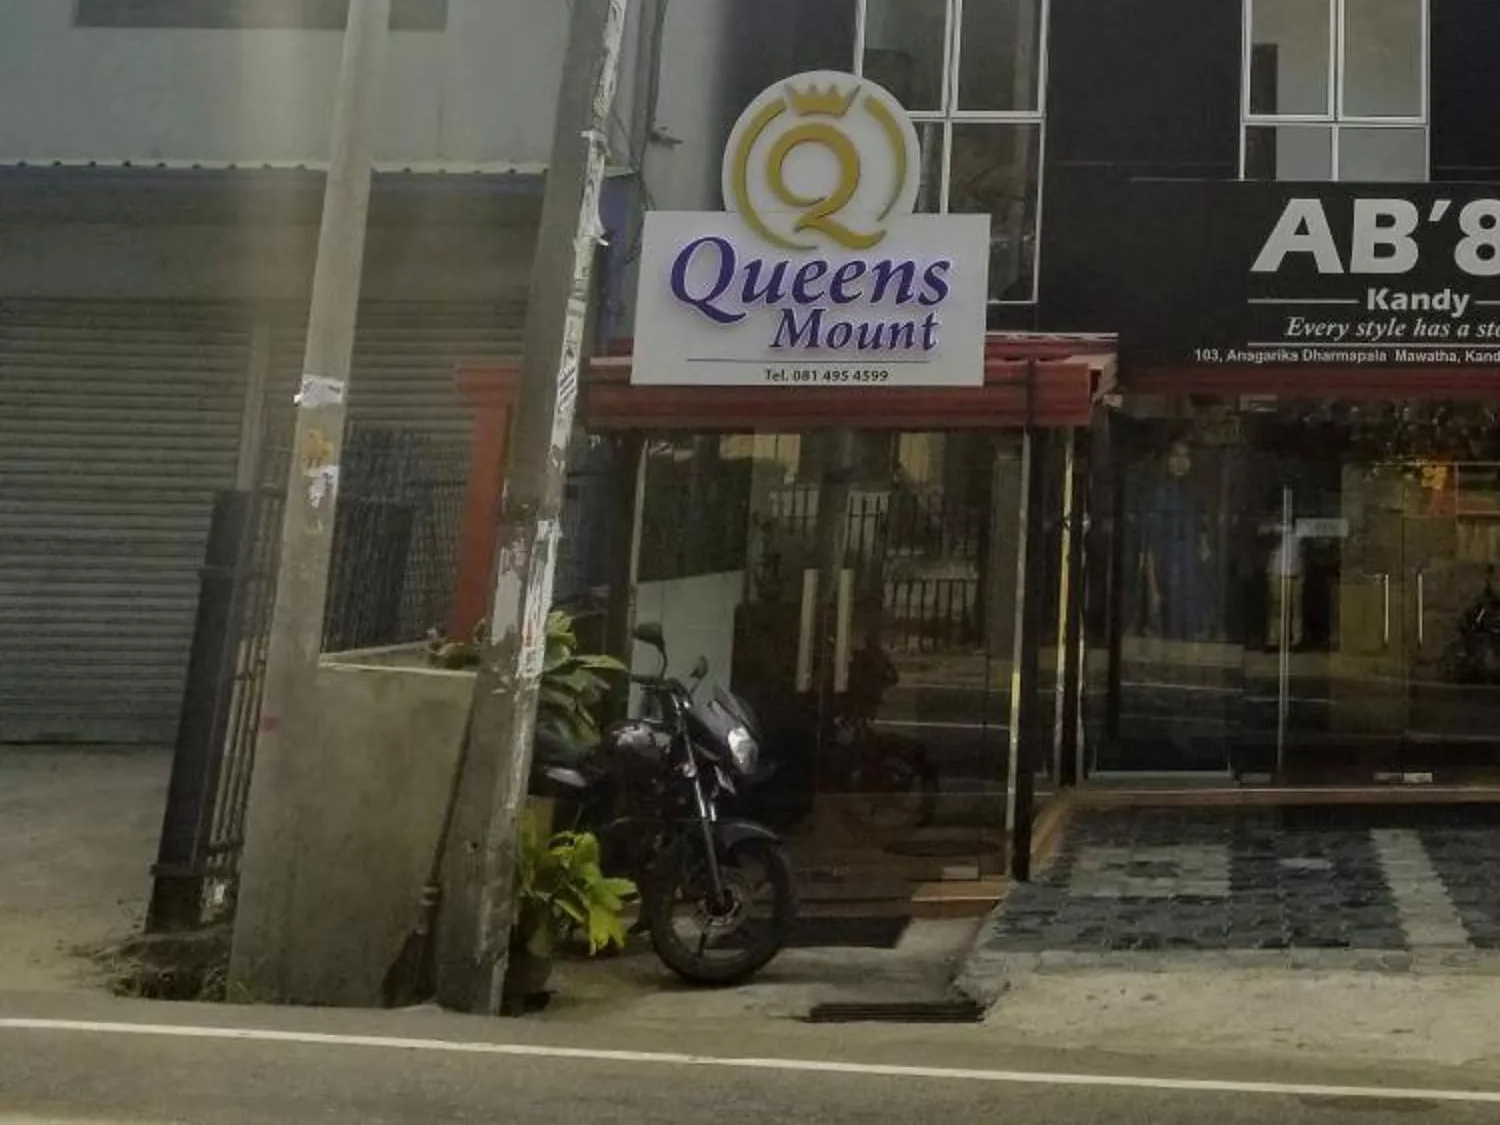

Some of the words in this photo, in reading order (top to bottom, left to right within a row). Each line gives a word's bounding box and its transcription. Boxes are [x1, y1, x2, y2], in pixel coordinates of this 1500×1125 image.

[670, 236, 952, 324] Queens
[1366, 287, 1472, 317] Kandy
[769, 308, 941, 351] Mount
[1284, 316, 1350, 341] Every
[1355, 318, 1406, 341] style
[1413, 318, 1451, 337] has
[1457, 324, 1471, 337] a
[1194, 348, 1223, 364] 103,
[1226, 348, 1300, 365] Anagarika
[1302, 348, 1388, 365] Dharmapala
[1394, 349, 1462, 365] Mawatha,
[793, 370, 818, 382] 081
[823, 370, 849, 382] 495
[853, 370, 889, 382] 4599
